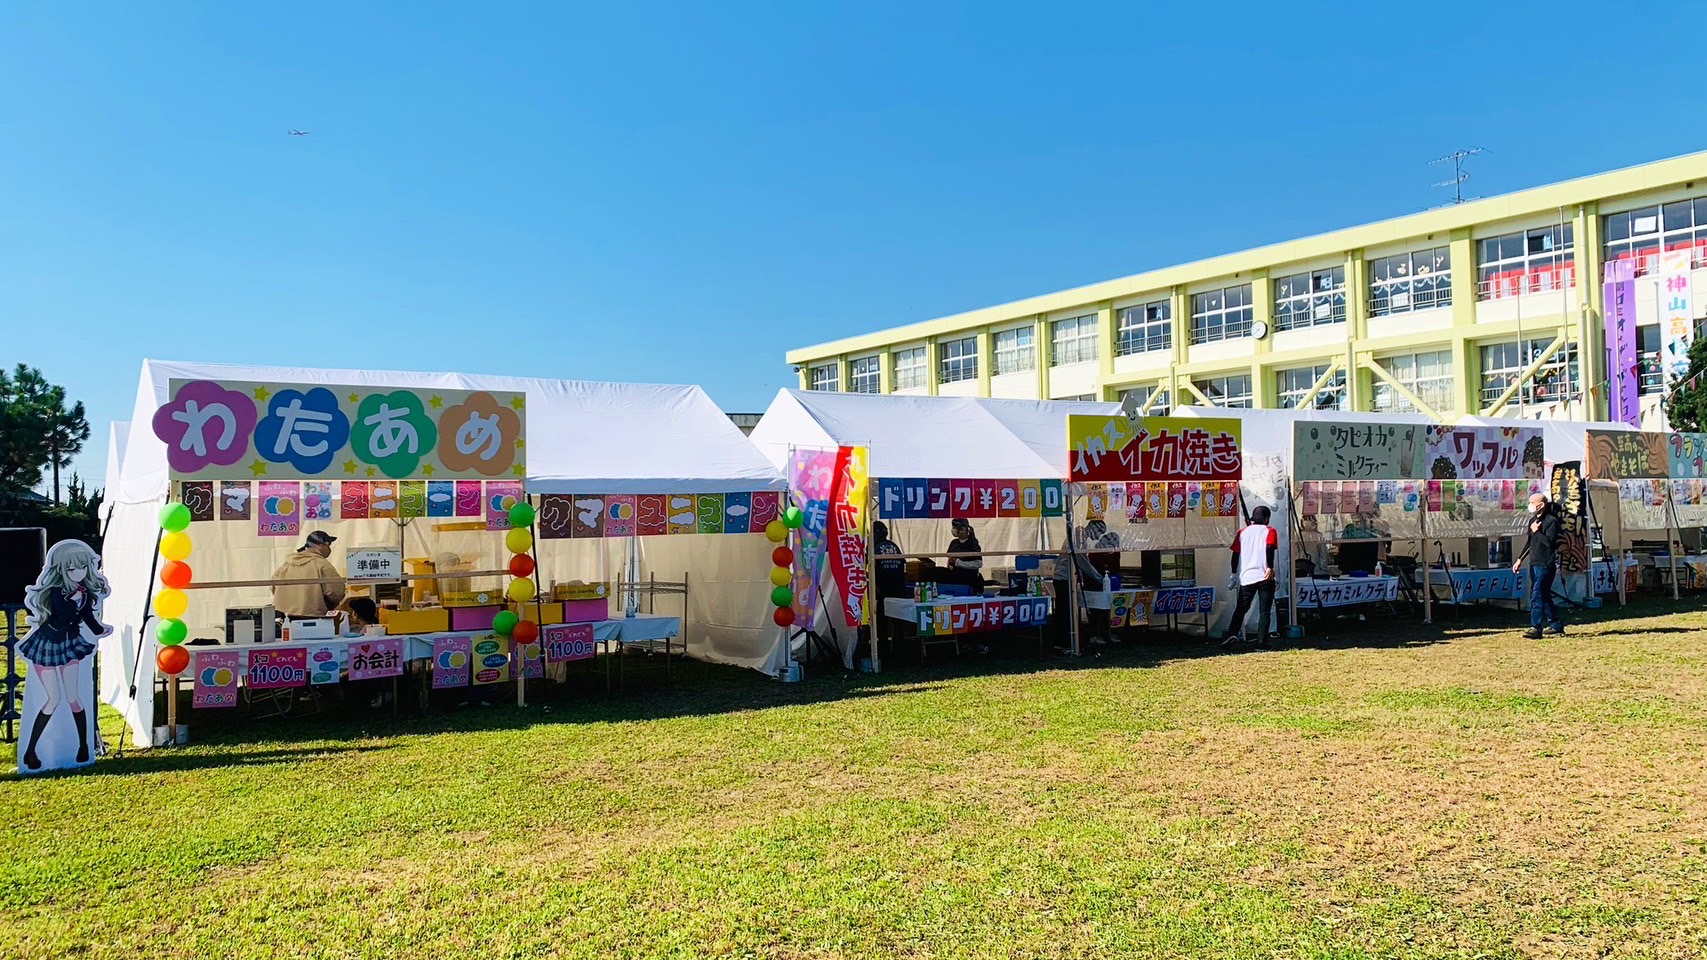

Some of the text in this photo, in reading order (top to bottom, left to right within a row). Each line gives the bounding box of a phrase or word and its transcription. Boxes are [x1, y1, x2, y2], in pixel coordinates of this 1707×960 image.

[172, 398, 502, 460] わたあめ
[1335, 425, 1388, 450] タピオカ
[1073, 418, 1126, 476] イカス
[1118, 427, 1241, 476] イカ焼き
[1452, 432, 1519, 478] ワッフル
[1669, 434, 1707, 458] フラン
[1335, 453, 1388, 479] ミルクティー
[1610, 448, 1650, 477] やきそば
[884, 486, 1059, 512] ドリンク¥200
[260, 521, 298, 532] わたあめ
[357, 558, 390, 571] 準備中
[1453, 575, 1523, 593] WAFFLE
[1156, 592, 1212, 611] イカ焼き
[920, 603, 1046, 631] ドリンク¥200
[252, 653, 269, 664] 1コ
[353, 649, 400, 671] お会計
[548, 639, 592, 659] 1100円
[249, 665, 305, 684] 1100円
[434, 674, 468, 685] わたあめ
[195, 693, 235, 704] わたあめ
